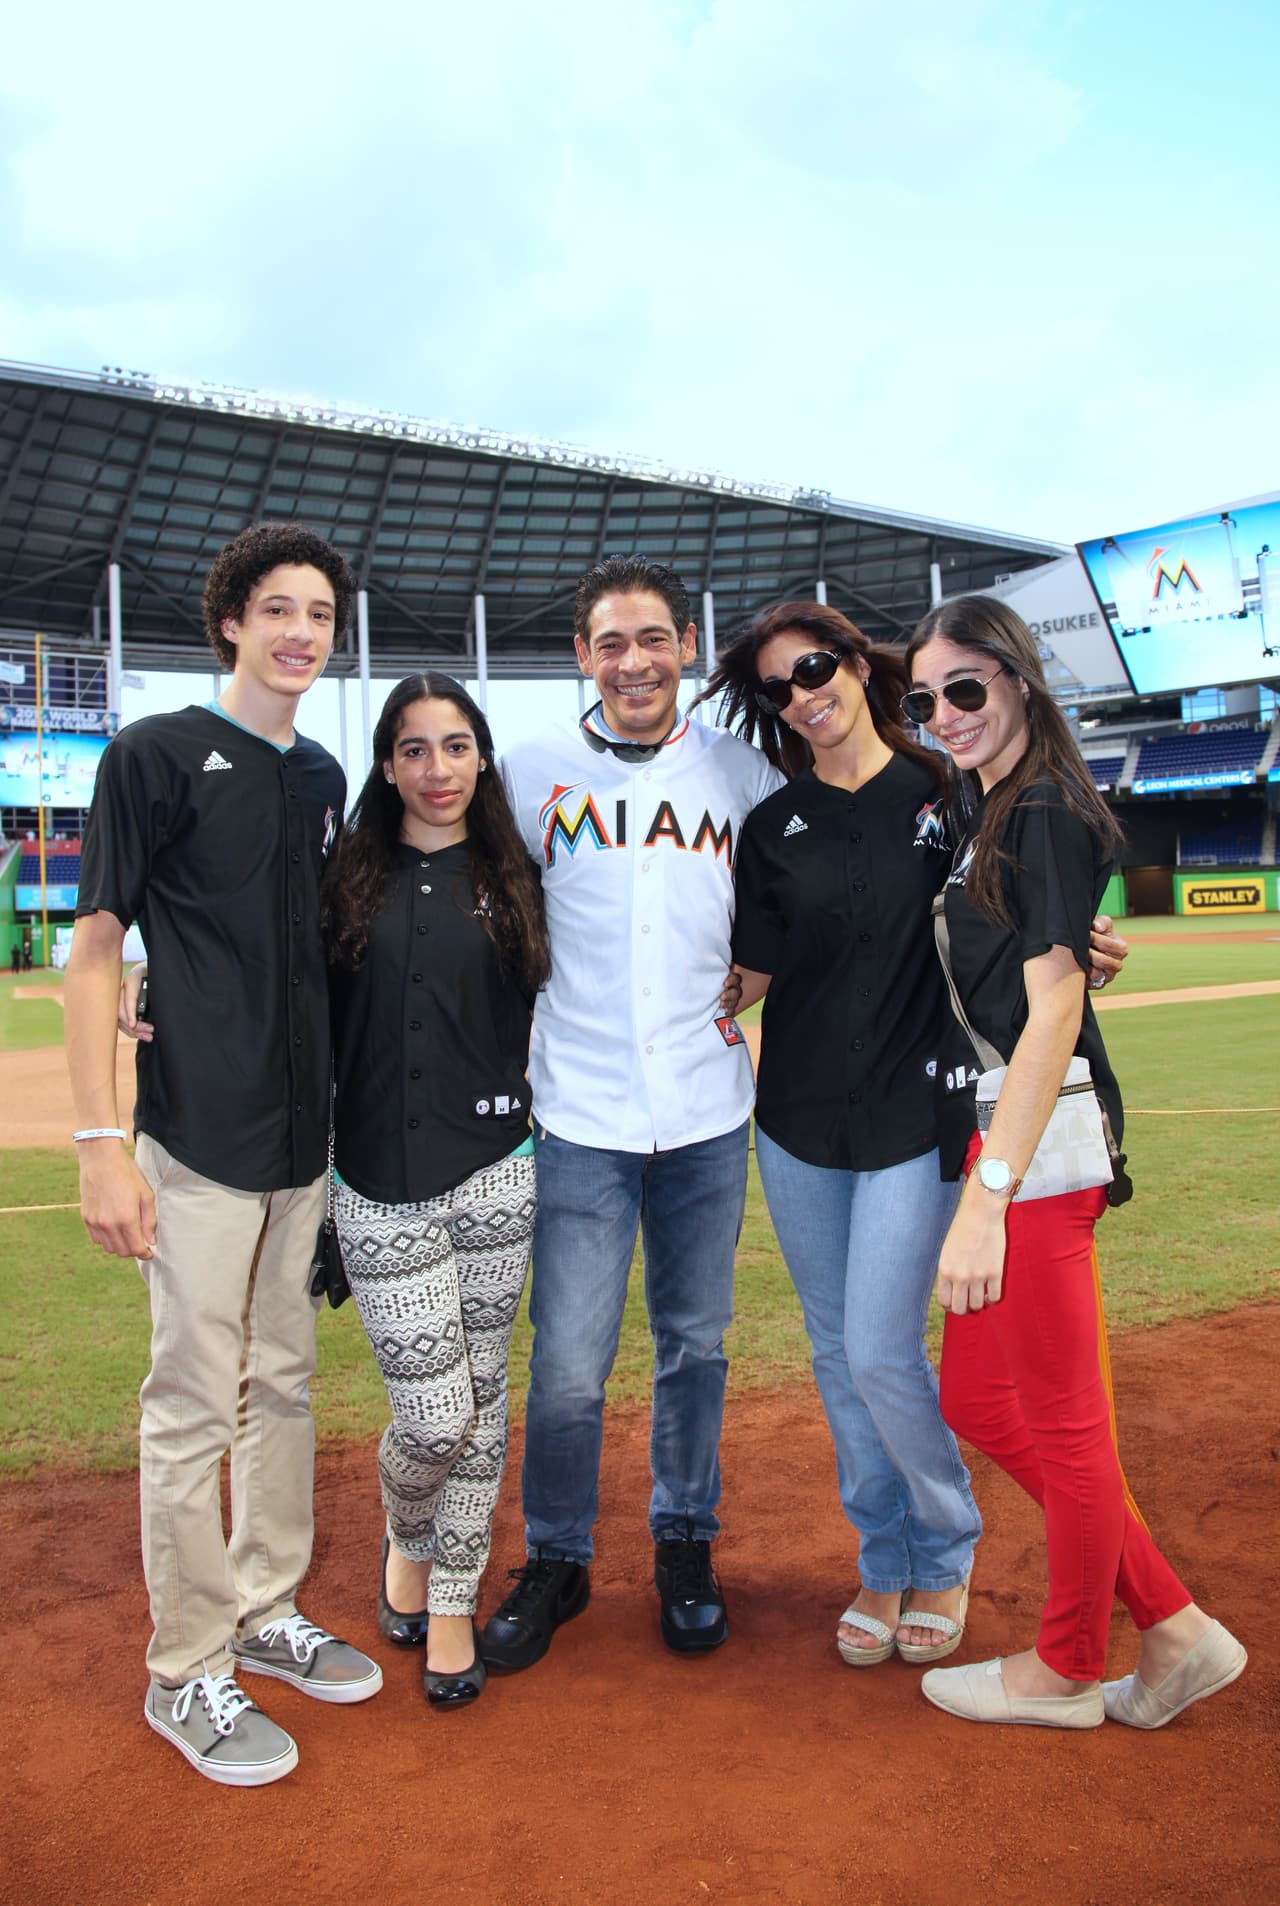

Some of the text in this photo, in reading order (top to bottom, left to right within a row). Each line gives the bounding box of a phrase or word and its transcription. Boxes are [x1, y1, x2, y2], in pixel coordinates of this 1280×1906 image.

[1148, 598, 1211, 615] MIAMI
[1029, 612, 1098, 636] OSUKEE
[49, 711, 98, 722] WORLD
[203, 762, 233, 771] adidas
[1146, 774, 1240, 790] LEON MEDICAL CENTERS
[541, 786, 734, 870] MIAM
[784, 822, 808, 837] adidas
[1192, 889, 1255, 904] STANLEY
